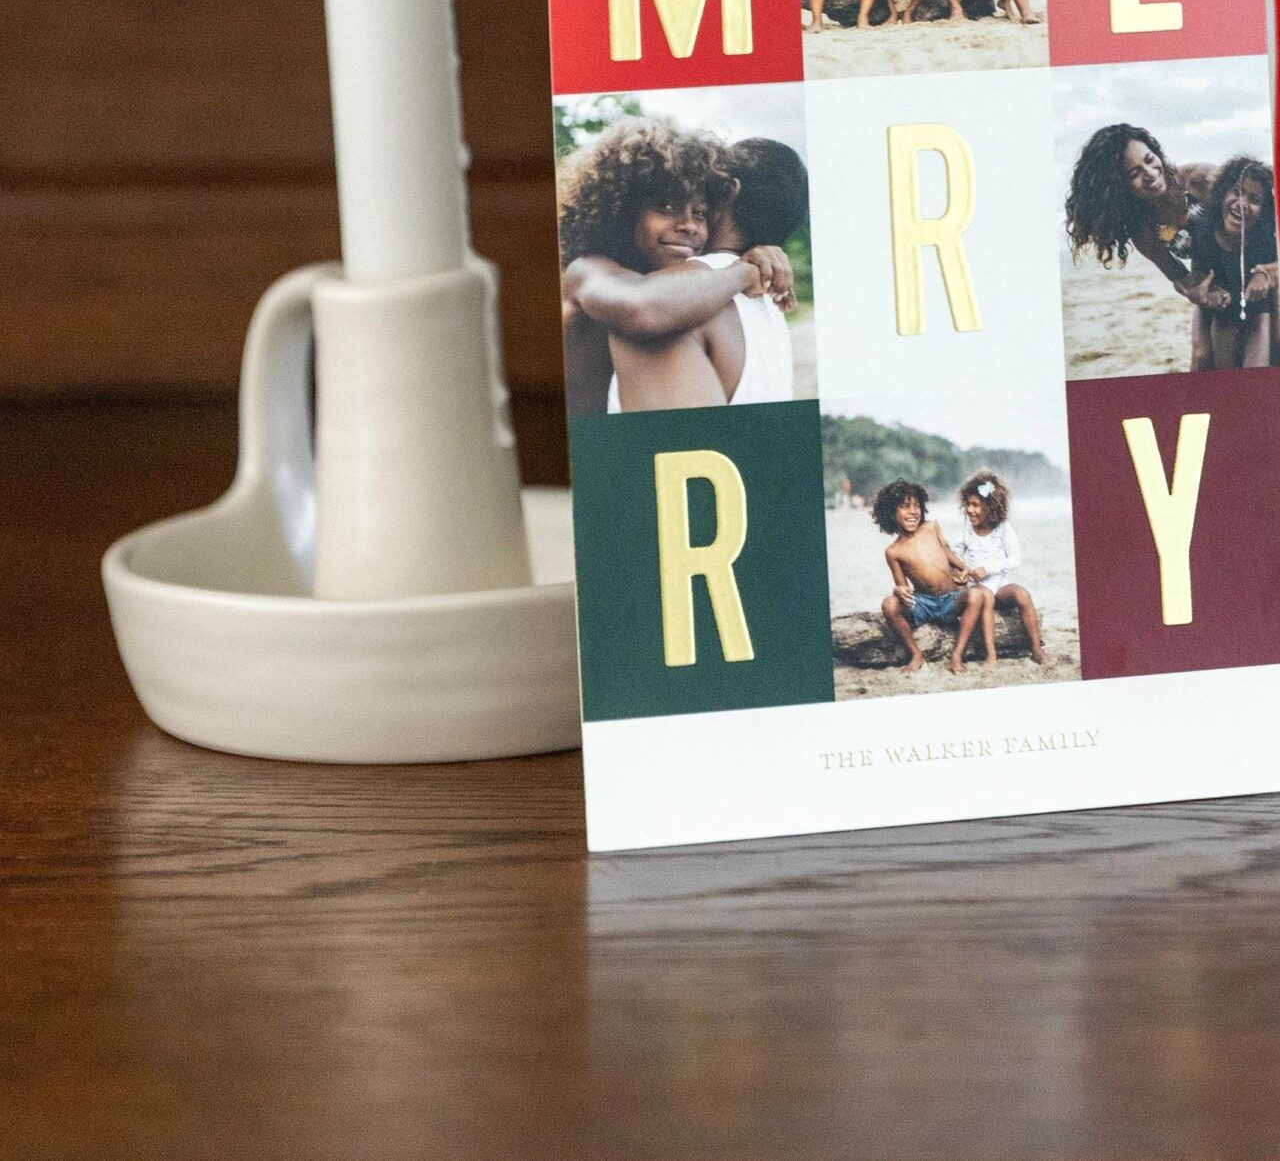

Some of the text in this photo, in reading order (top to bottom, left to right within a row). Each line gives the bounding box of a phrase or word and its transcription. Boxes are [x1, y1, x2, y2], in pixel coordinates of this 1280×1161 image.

[819, 729, 1101, 771] THE WALKER FAMILY
